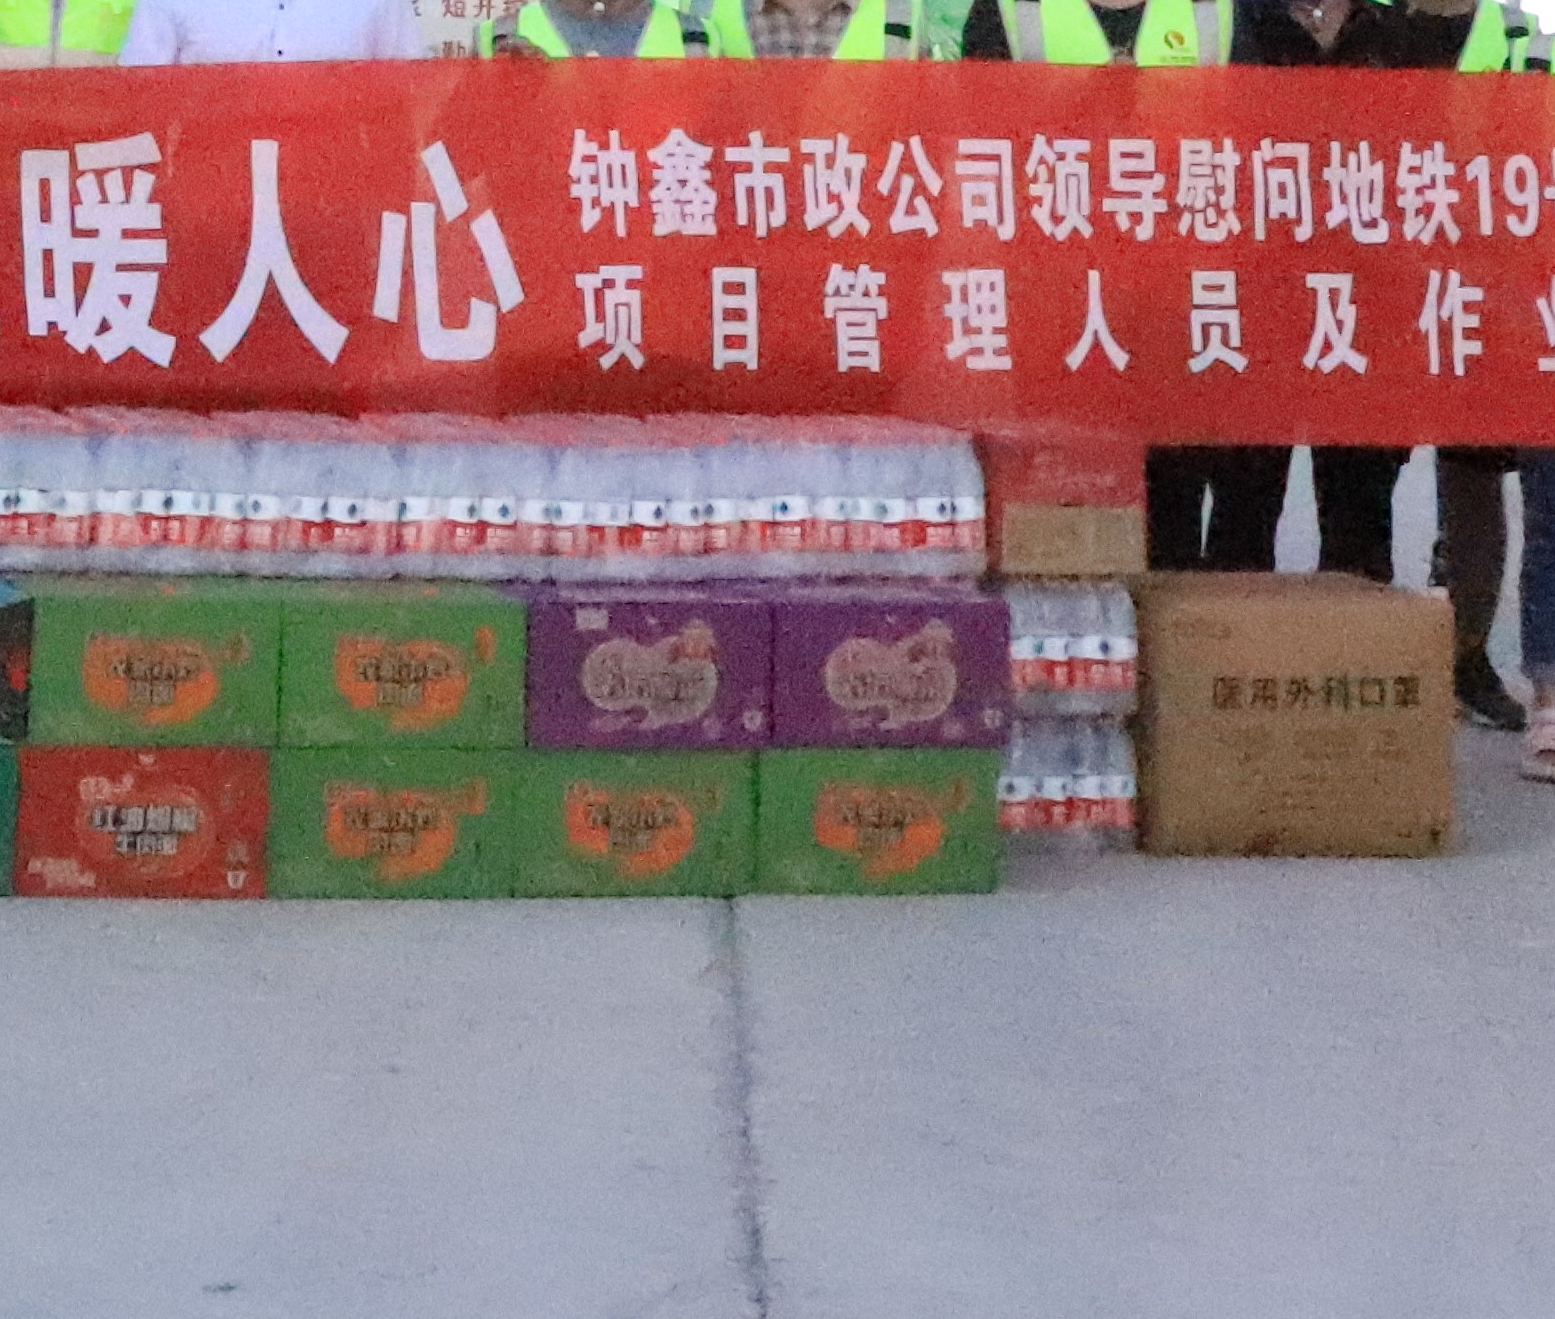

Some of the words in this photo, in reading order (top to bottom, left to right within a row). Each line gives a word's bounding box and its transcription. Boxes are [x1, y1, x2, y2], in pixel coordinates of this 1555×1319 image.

[1212, 675, 1422, 710] 医用外科口罩
